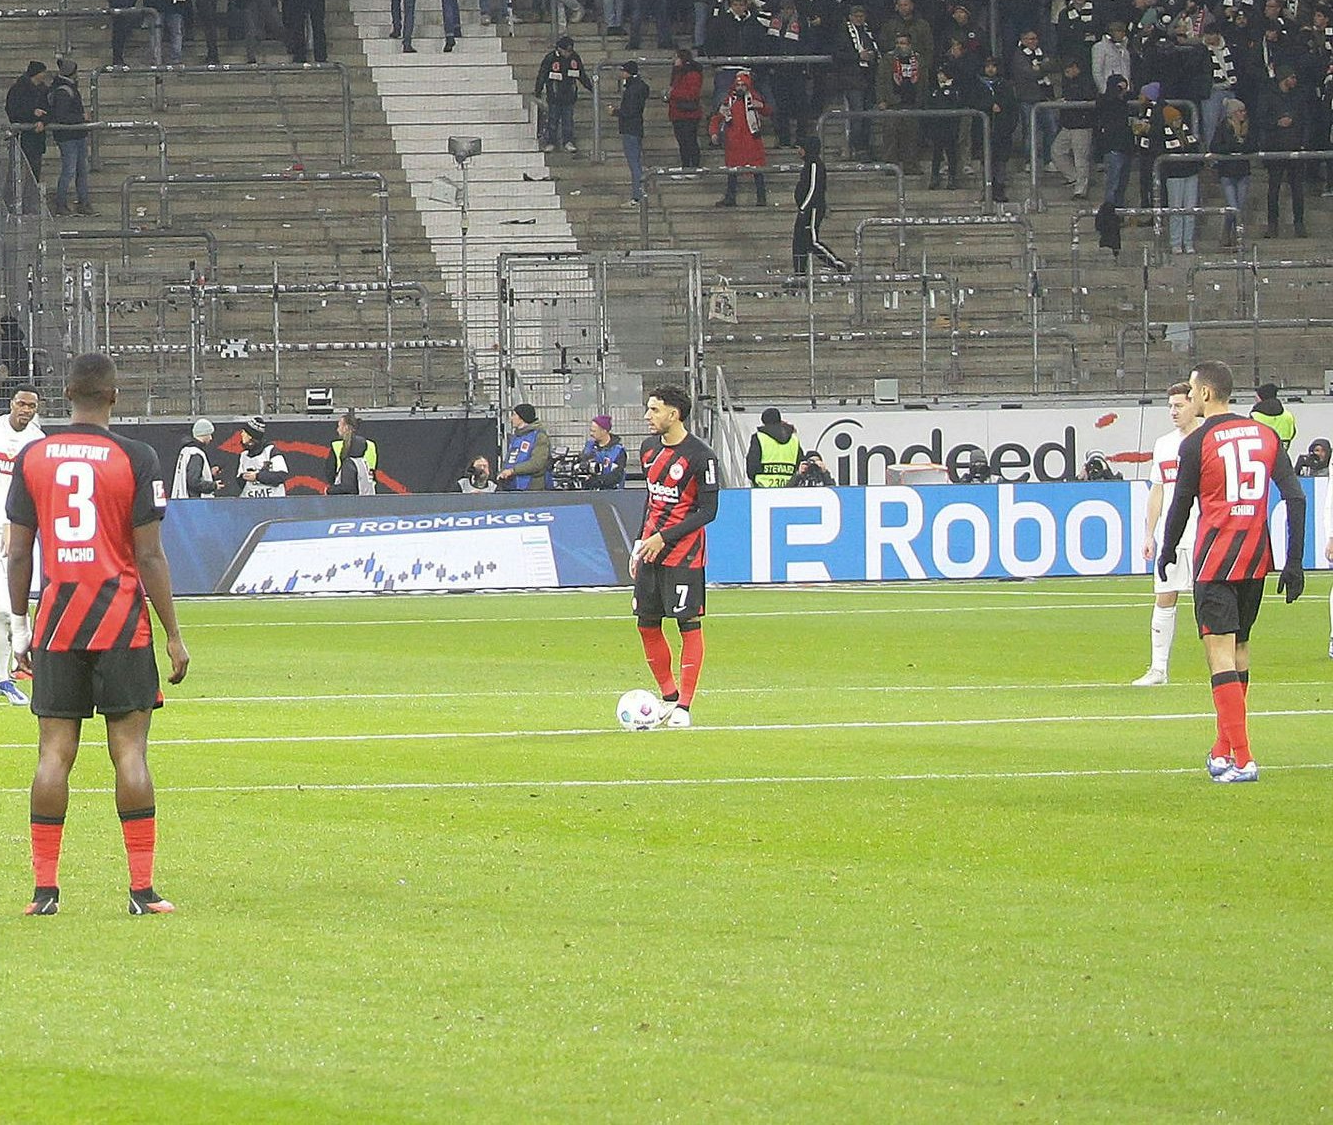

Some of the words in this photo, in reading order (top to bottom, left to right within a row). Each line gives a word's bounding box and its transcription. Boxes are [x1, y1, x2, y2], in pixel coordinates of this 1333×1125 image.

[1213, 425, 1260, 442] FRANKFURT
[45, 443, 111, 461] FRANKFURT
[1216, 438, 1266, 503] 15
[54, 461, 97, 543] 3
[359, 511, 555, 534] RoboMarkets
[57, 547, 95, 563] PACHO
[675, 584, 689, 607] 7
